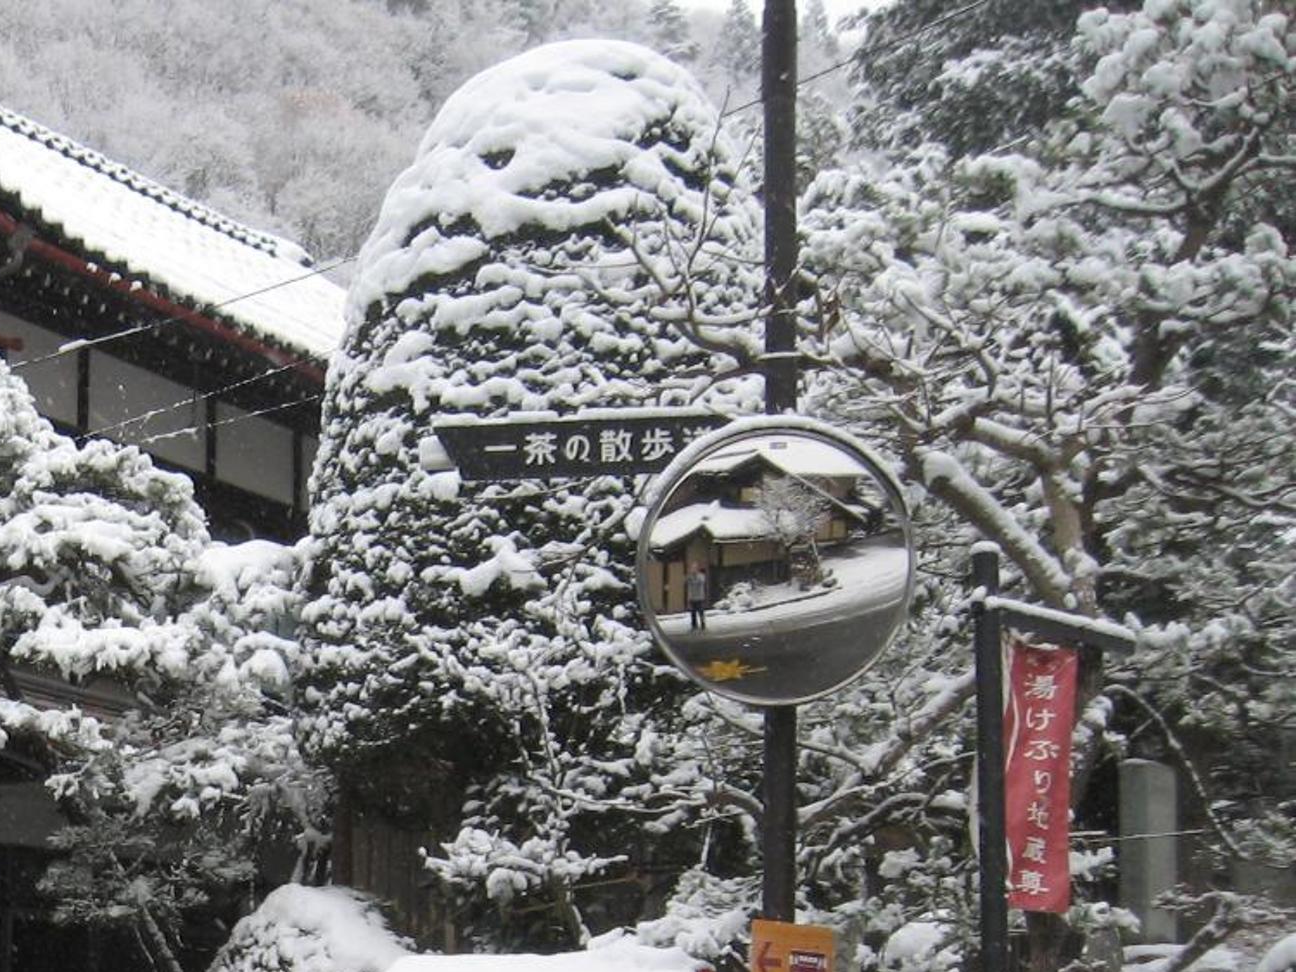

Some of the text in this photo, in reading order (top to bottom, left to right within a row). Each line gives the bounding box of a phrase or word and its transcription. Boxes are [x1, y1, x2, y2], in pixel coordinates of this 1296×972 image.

[1015, 674, 1059, 895] 湯けぶり地蔵尊
